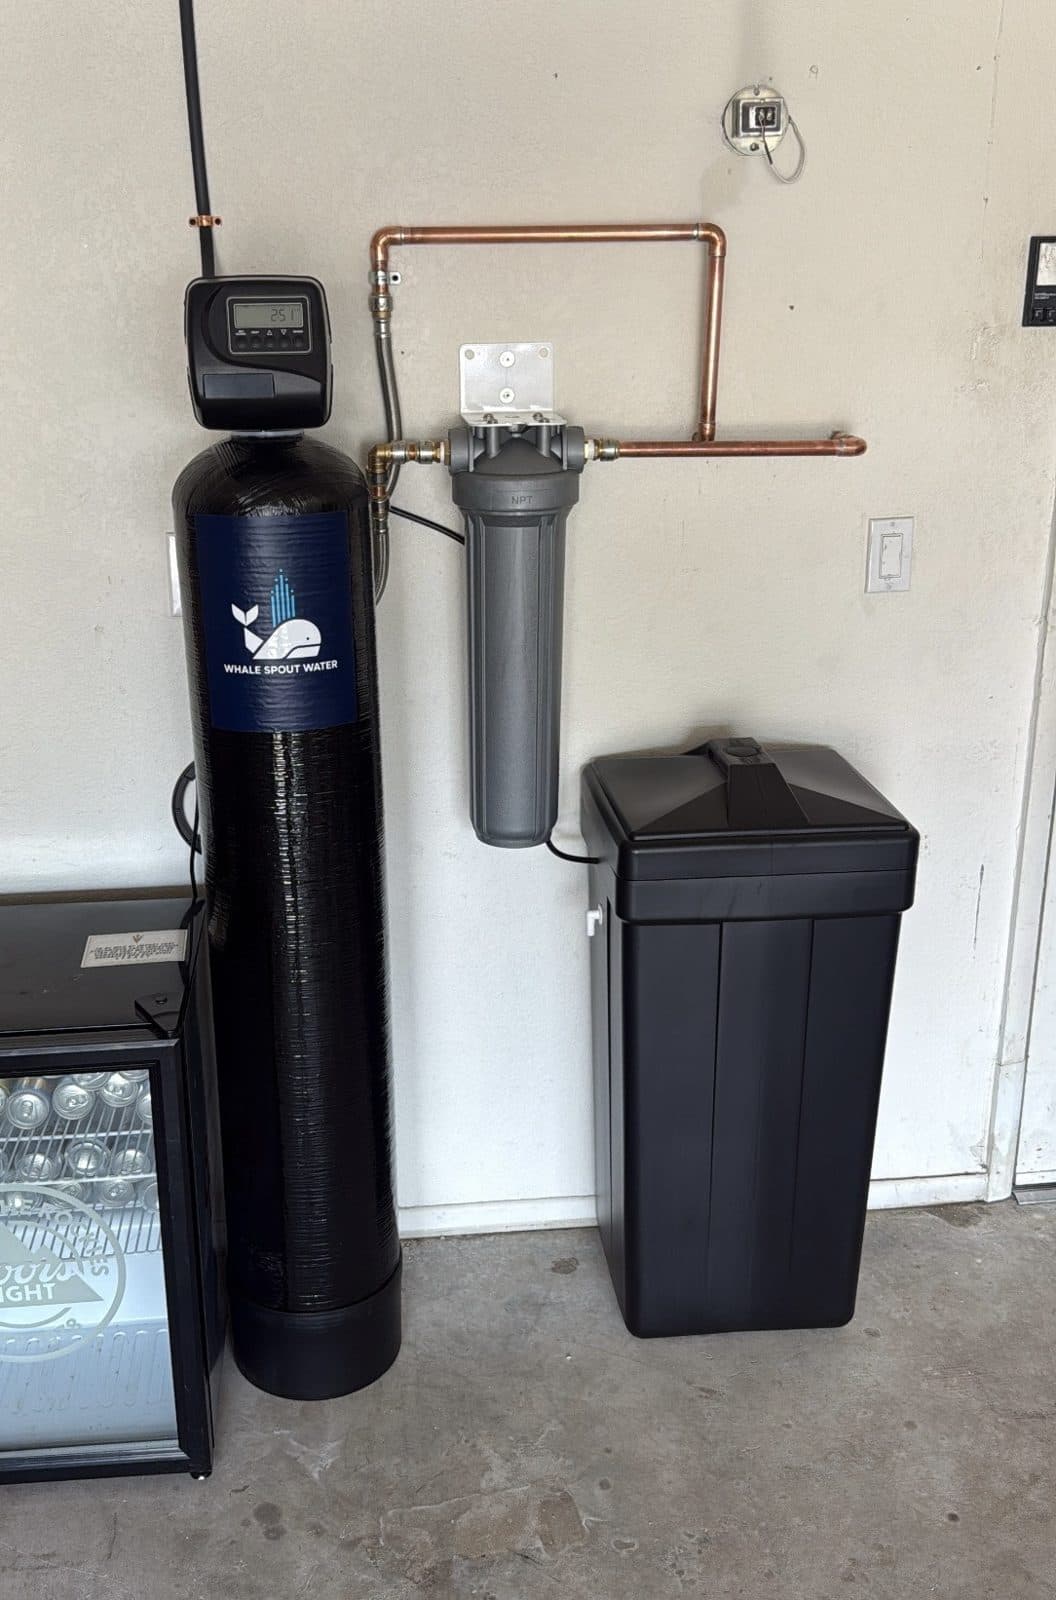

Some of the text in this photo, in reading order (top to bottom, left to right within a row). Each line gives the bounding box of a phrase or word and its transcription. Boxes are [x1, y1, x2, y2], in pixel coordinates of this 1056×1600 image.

[511, 496, 532, 504] NPT
[224, 660, 338, 675] WHALE SPOUT WATER
[0, 1262, 74, 1285] oors
[0, 1282, 56, 1303] IGHT
